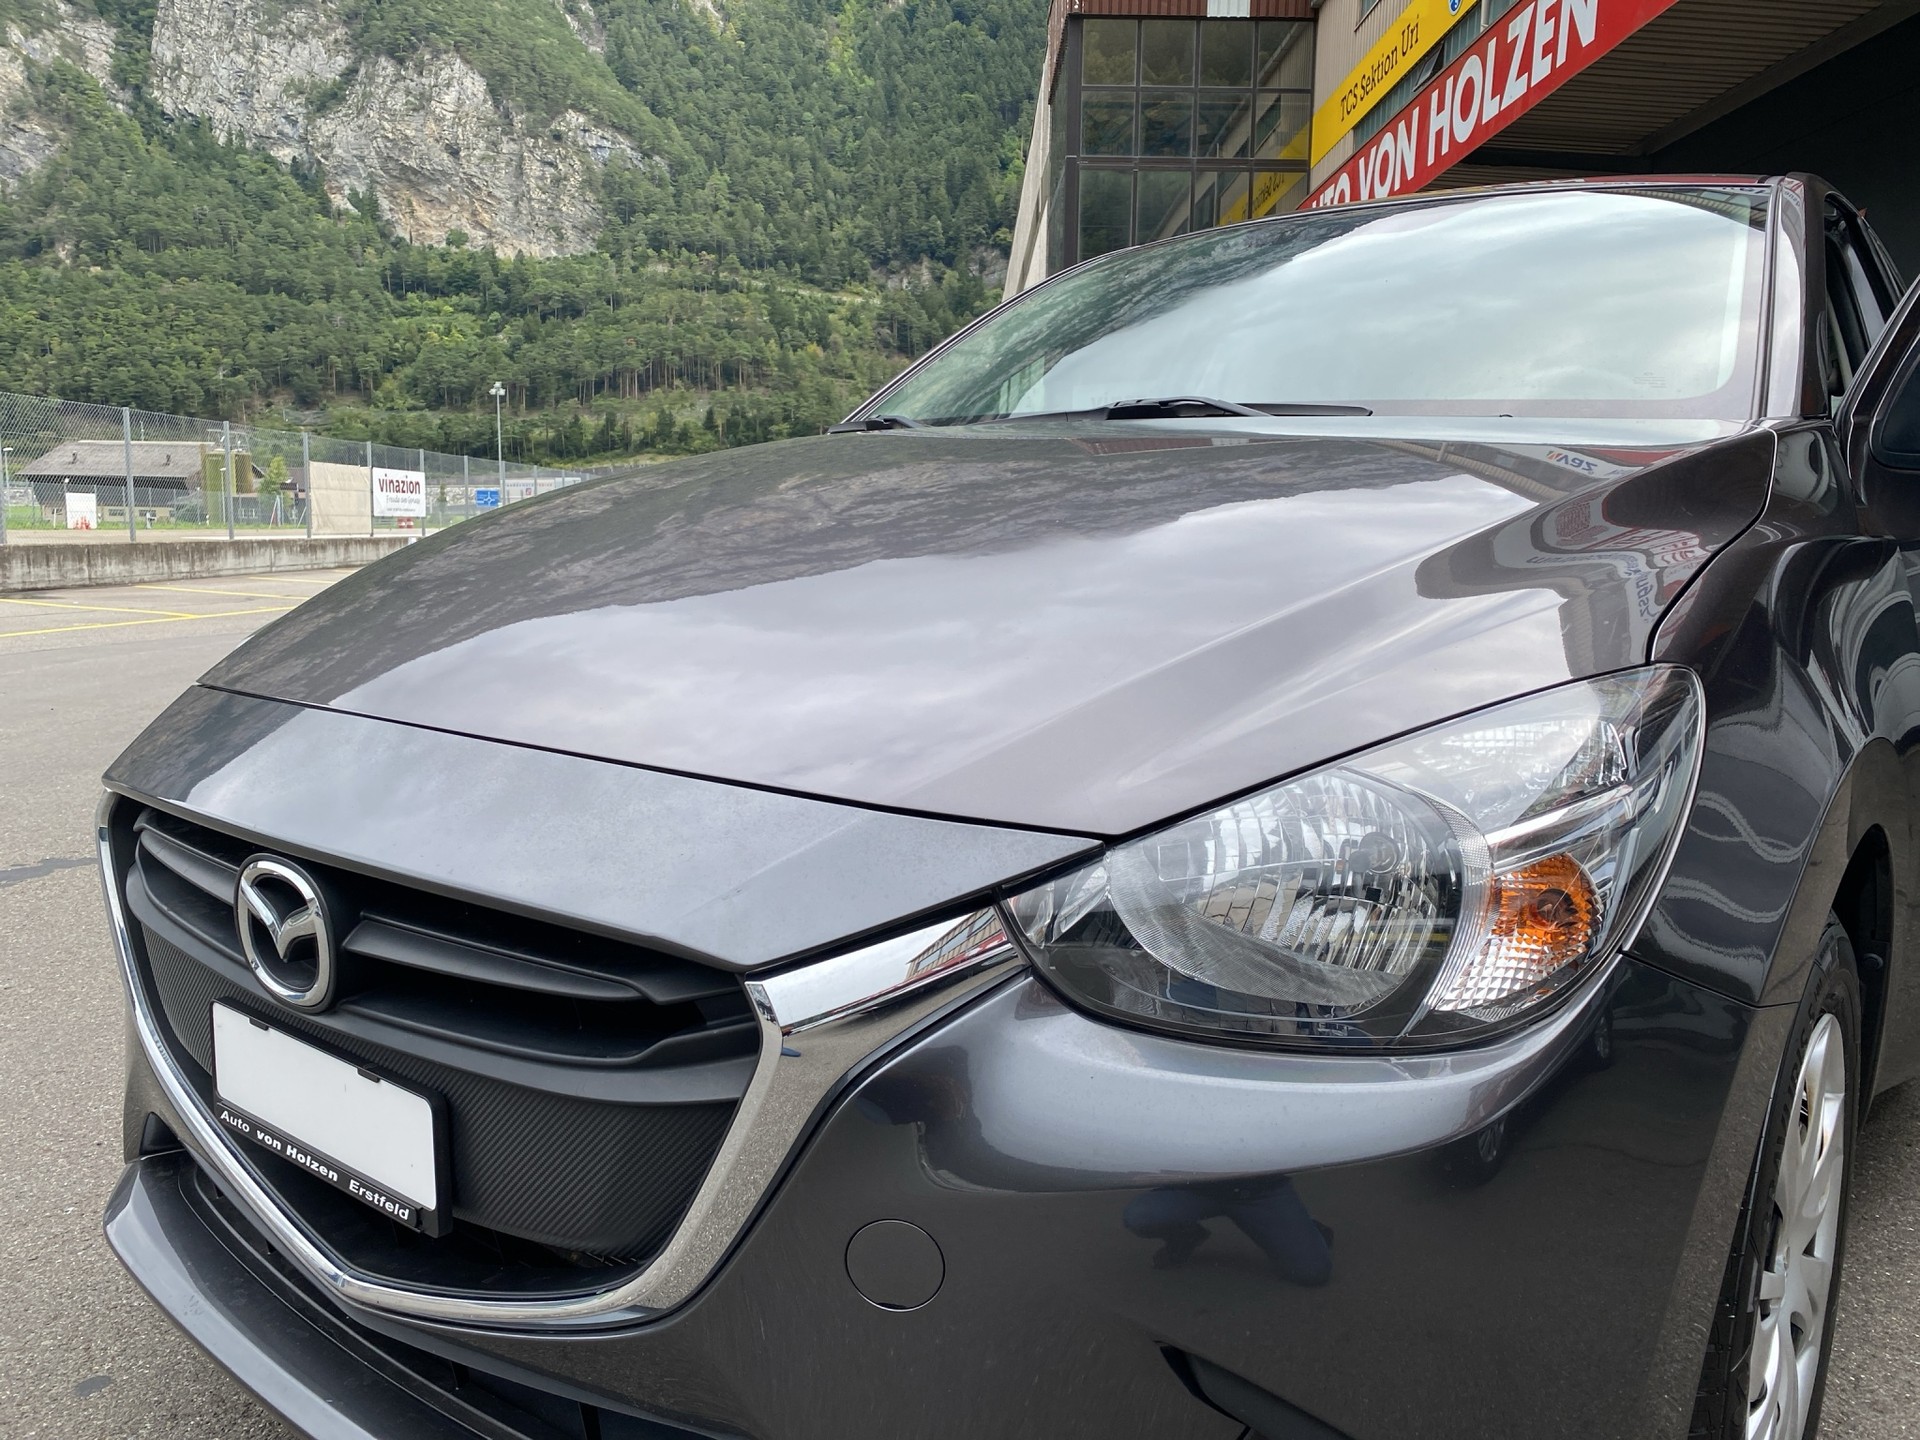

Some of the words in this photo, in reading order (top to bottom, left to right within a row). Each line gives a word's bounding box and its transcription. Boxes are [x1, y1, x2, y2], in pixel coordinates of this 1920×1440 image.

[1340, 86, 1358, 122] TCS
[1360, 49, 1398, 102] Sektion
[1401, 13, 1420, 56] Uri
[1358, 106, 1420, 201] VON
[1427, 0, 1598, 167] HOLZEN
[378, 473, 421, 495] vinazion
[220, 1110, 250, 1133] Auto
[256, 1129, 281, 1151] von
[286, 1144, 339, 1182] Holzen
[349, 1179, 410, 1221] Erstfeld
